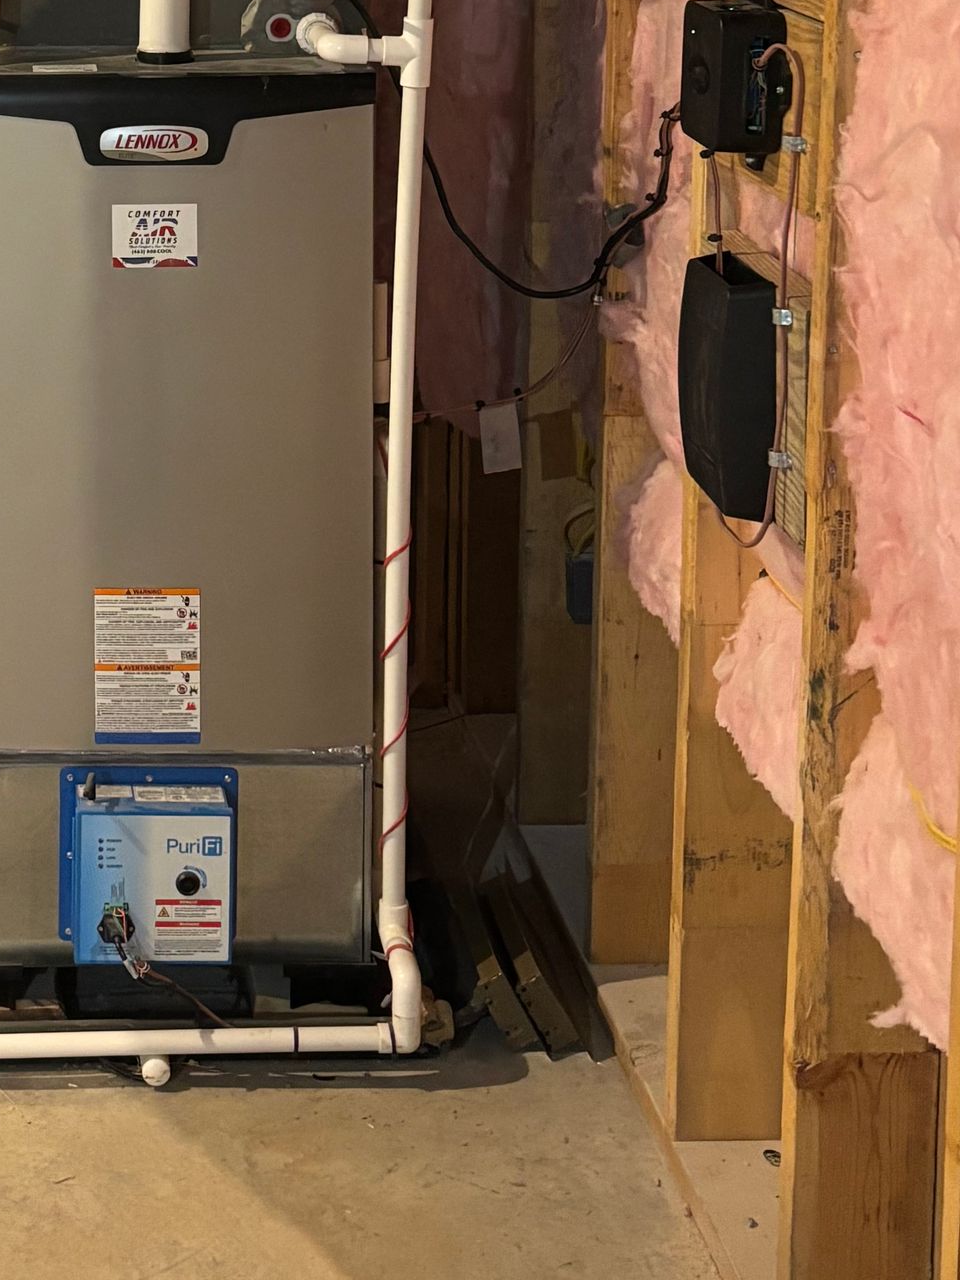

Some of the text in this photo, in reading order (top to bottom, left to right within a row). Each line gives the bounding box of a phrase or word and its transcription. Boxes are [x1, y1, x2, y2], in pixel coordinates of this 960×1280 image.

[115, 134, 181, 149] LENNOX
[128, 210, 181, 218] COMFORT
[129, 237, 178, 245] SOLUTIONS
[167, 838, 220, 854] PuriFi
